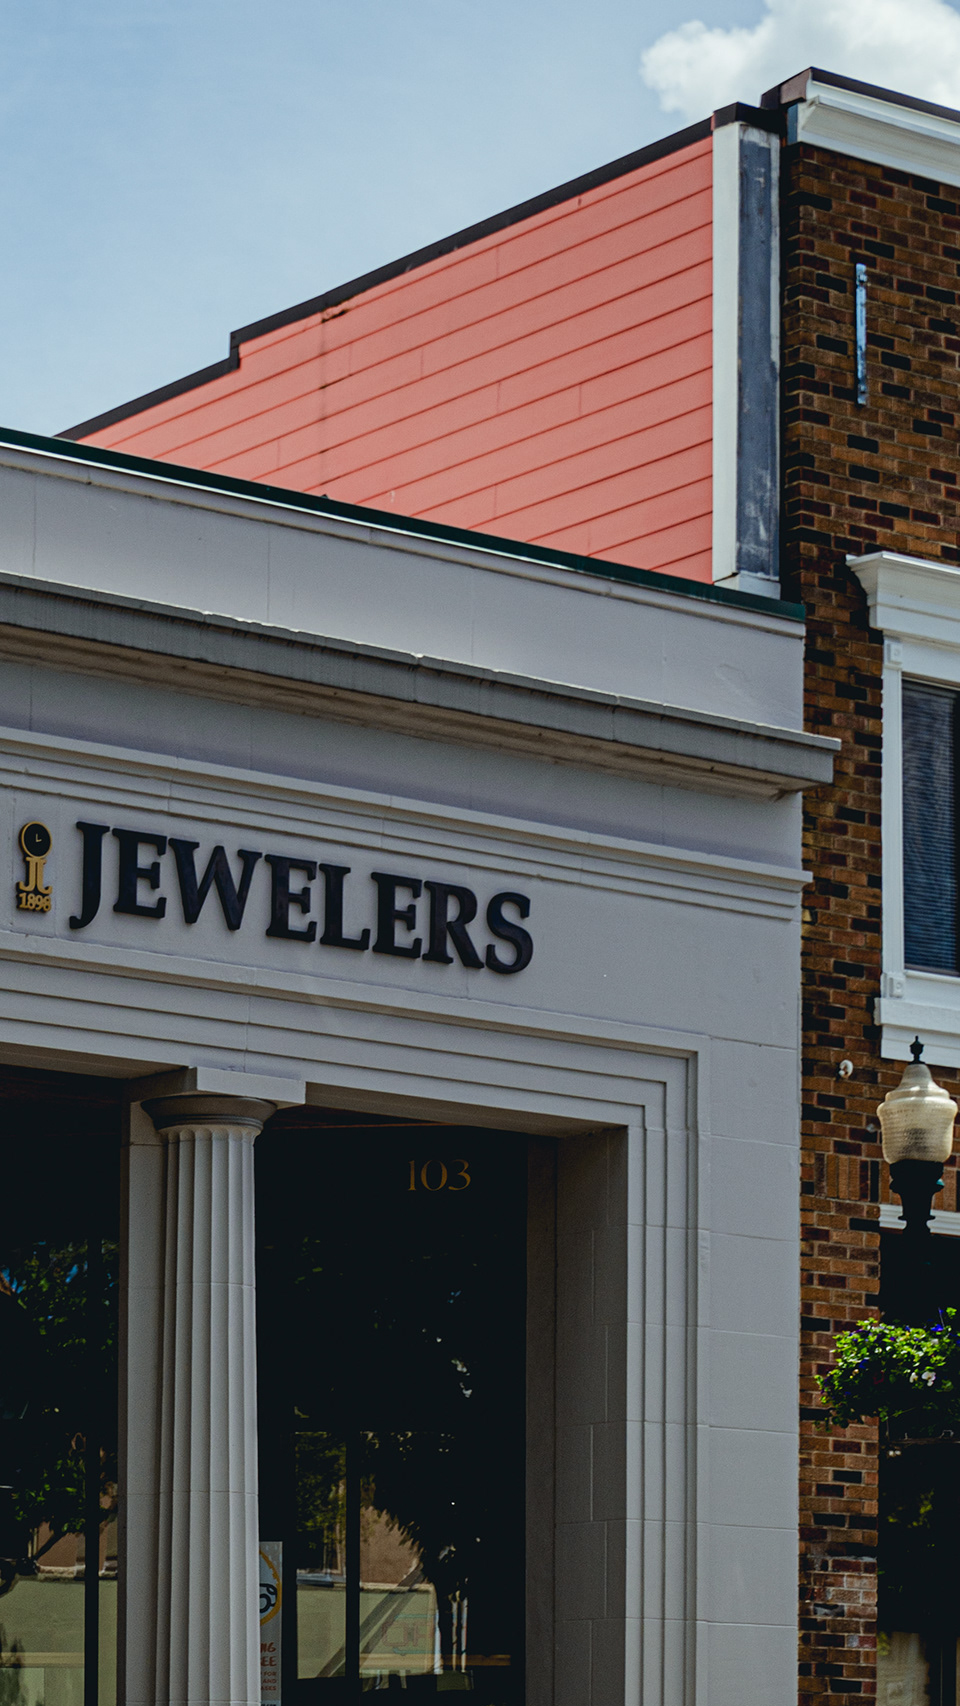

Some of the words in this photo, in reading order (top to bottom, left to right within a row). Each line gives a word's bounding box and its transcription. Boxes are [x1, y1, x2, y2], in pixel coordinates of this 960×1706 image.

[69, 820, 534, 974] JEWELERS
[407, 1159, 471, 1191] 103
[261, 1642, 277, 1653] NG
[261, 1656, 277, 1667] EE
